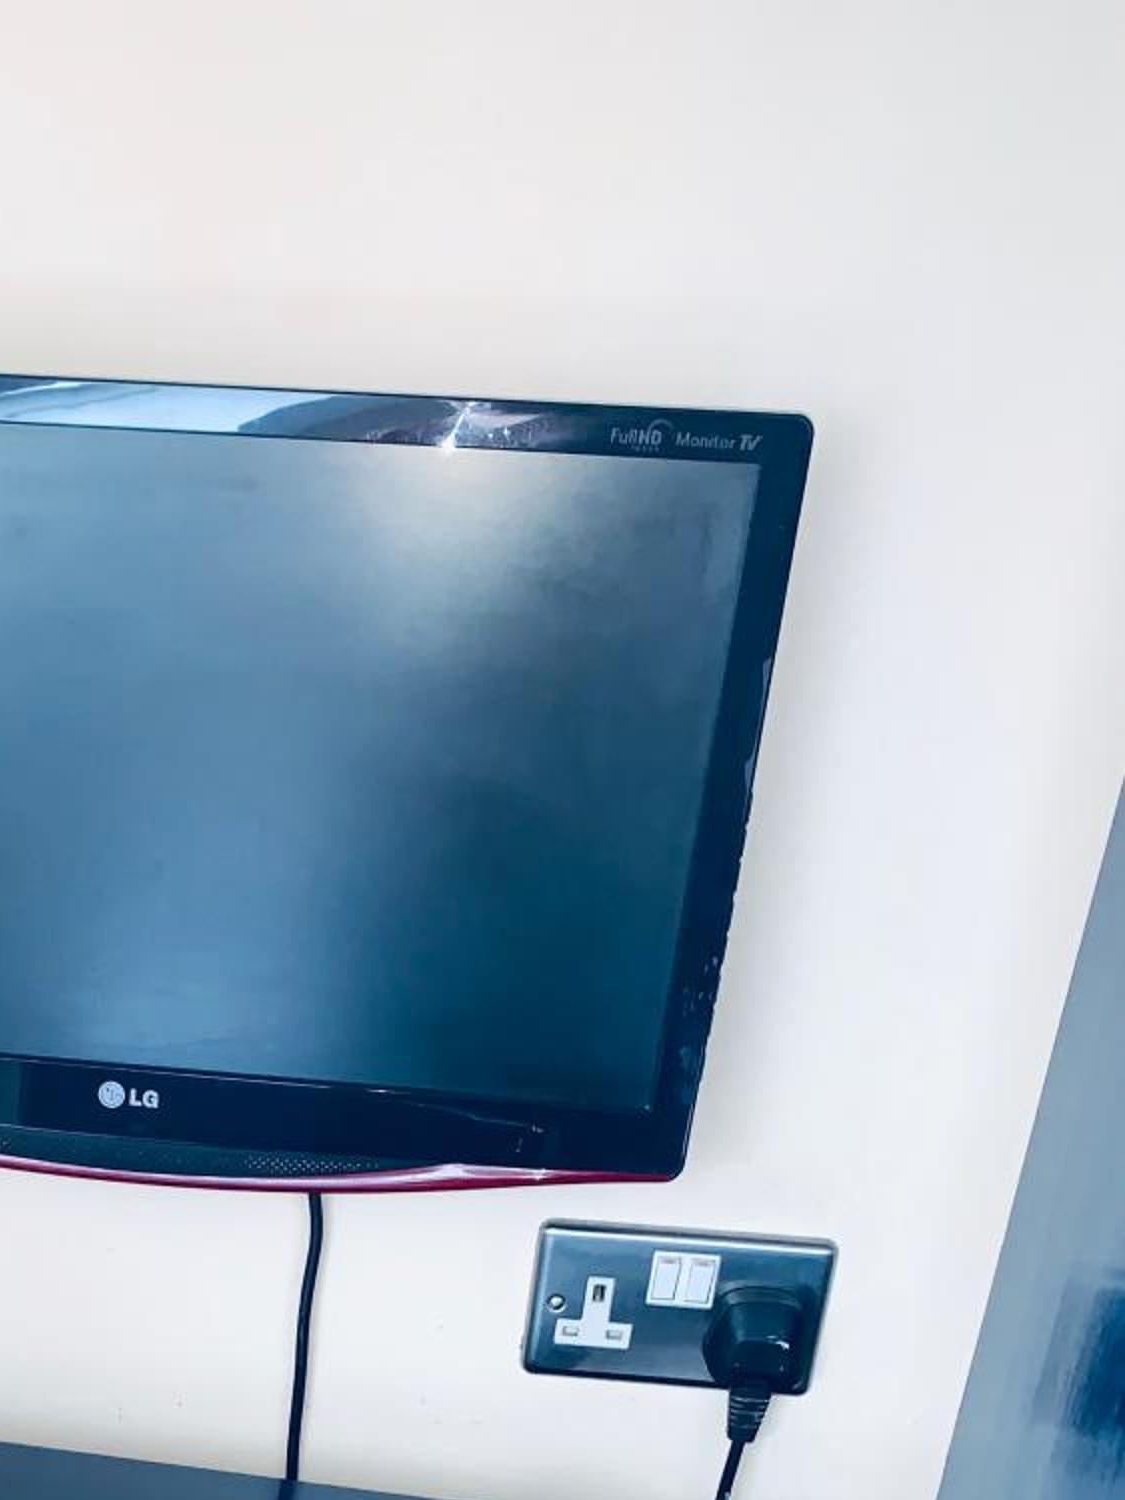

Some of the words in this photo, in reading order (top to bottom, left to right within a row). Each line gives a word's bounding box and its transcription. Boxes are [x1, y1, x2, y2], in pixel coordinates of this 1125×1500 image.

[675, 432, 737, 449] Monitor
[740, 434, 763, 450] TV
[129, 1088, 160, 1108] LG
